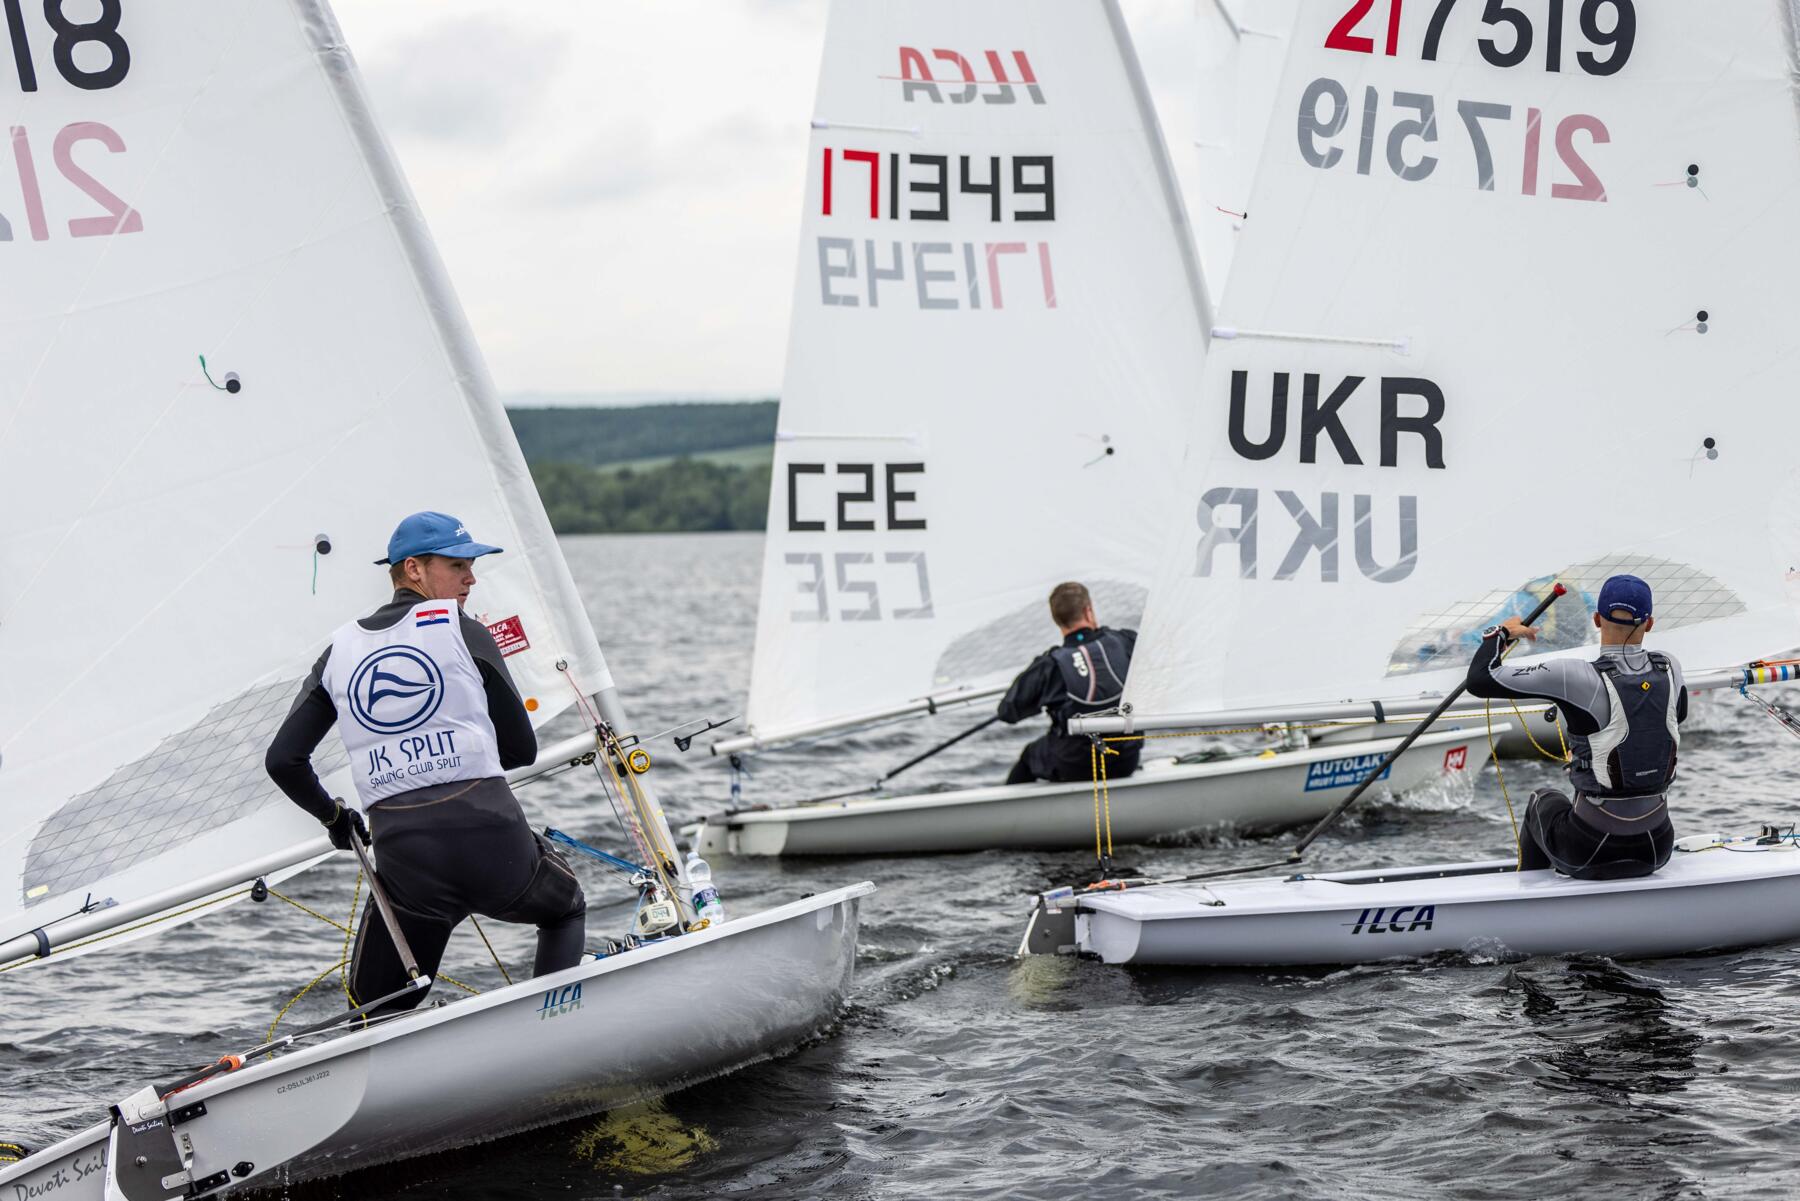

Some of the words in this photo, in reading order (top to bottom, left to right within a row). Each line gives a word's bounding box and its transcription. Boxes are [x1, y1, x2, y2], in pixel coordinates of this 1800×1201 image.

[1324, 0, 1637, 77] 217519
[822, 147, 1057, 223] 171349
[1227, 370, 1446, 470] UKR
[368, 745, 393, 776] JK
[399, 730, 455, 763] SPLIT
[370, 768, 405, 789] SAILING
[407, 761, 434, 776] CLUB
[437, 755, 462, 770] SPLIT
[1350, 904, 1436, 935] ILCA
[537, 982, 583, 1021] ILCA
[13, 1168, 70, 1201] Devoti
